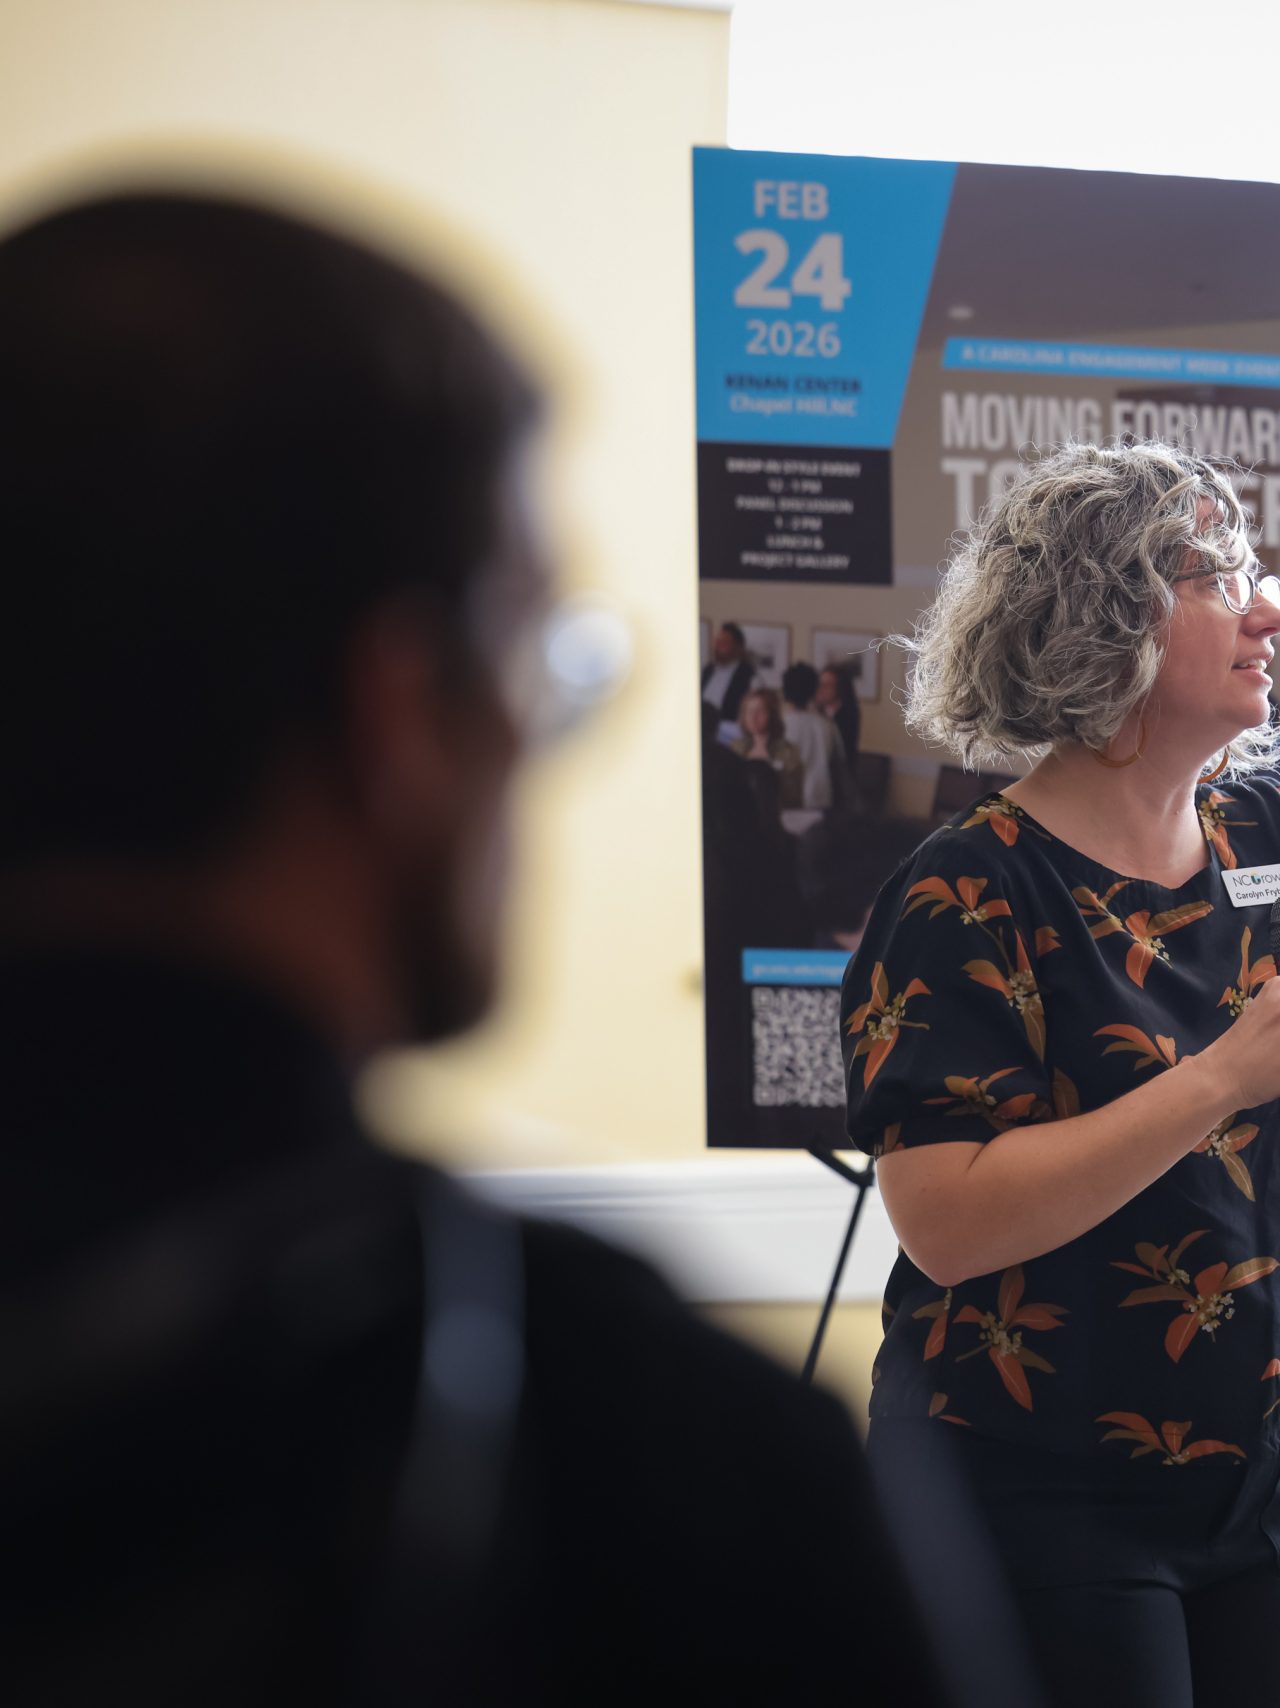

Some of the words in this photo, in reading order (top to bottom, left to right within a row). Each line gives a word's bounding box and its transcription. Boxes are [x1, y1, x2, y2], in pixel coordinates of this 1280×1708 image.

[754, 179, 829, 220] FEB
[733, 228, 851, 312] 24
[746, 319, 841, 358] 2026
[979, 347, 1064, 365] CAROLINA
[725, 373, 789, 392] KENAN
[794, 375, 862, 394] CENTER
[730, 392, 793, 416] Chapel
[941, 391, 1103, 449] MOVING
[1236, 889, 1265, 900] Carolyn
